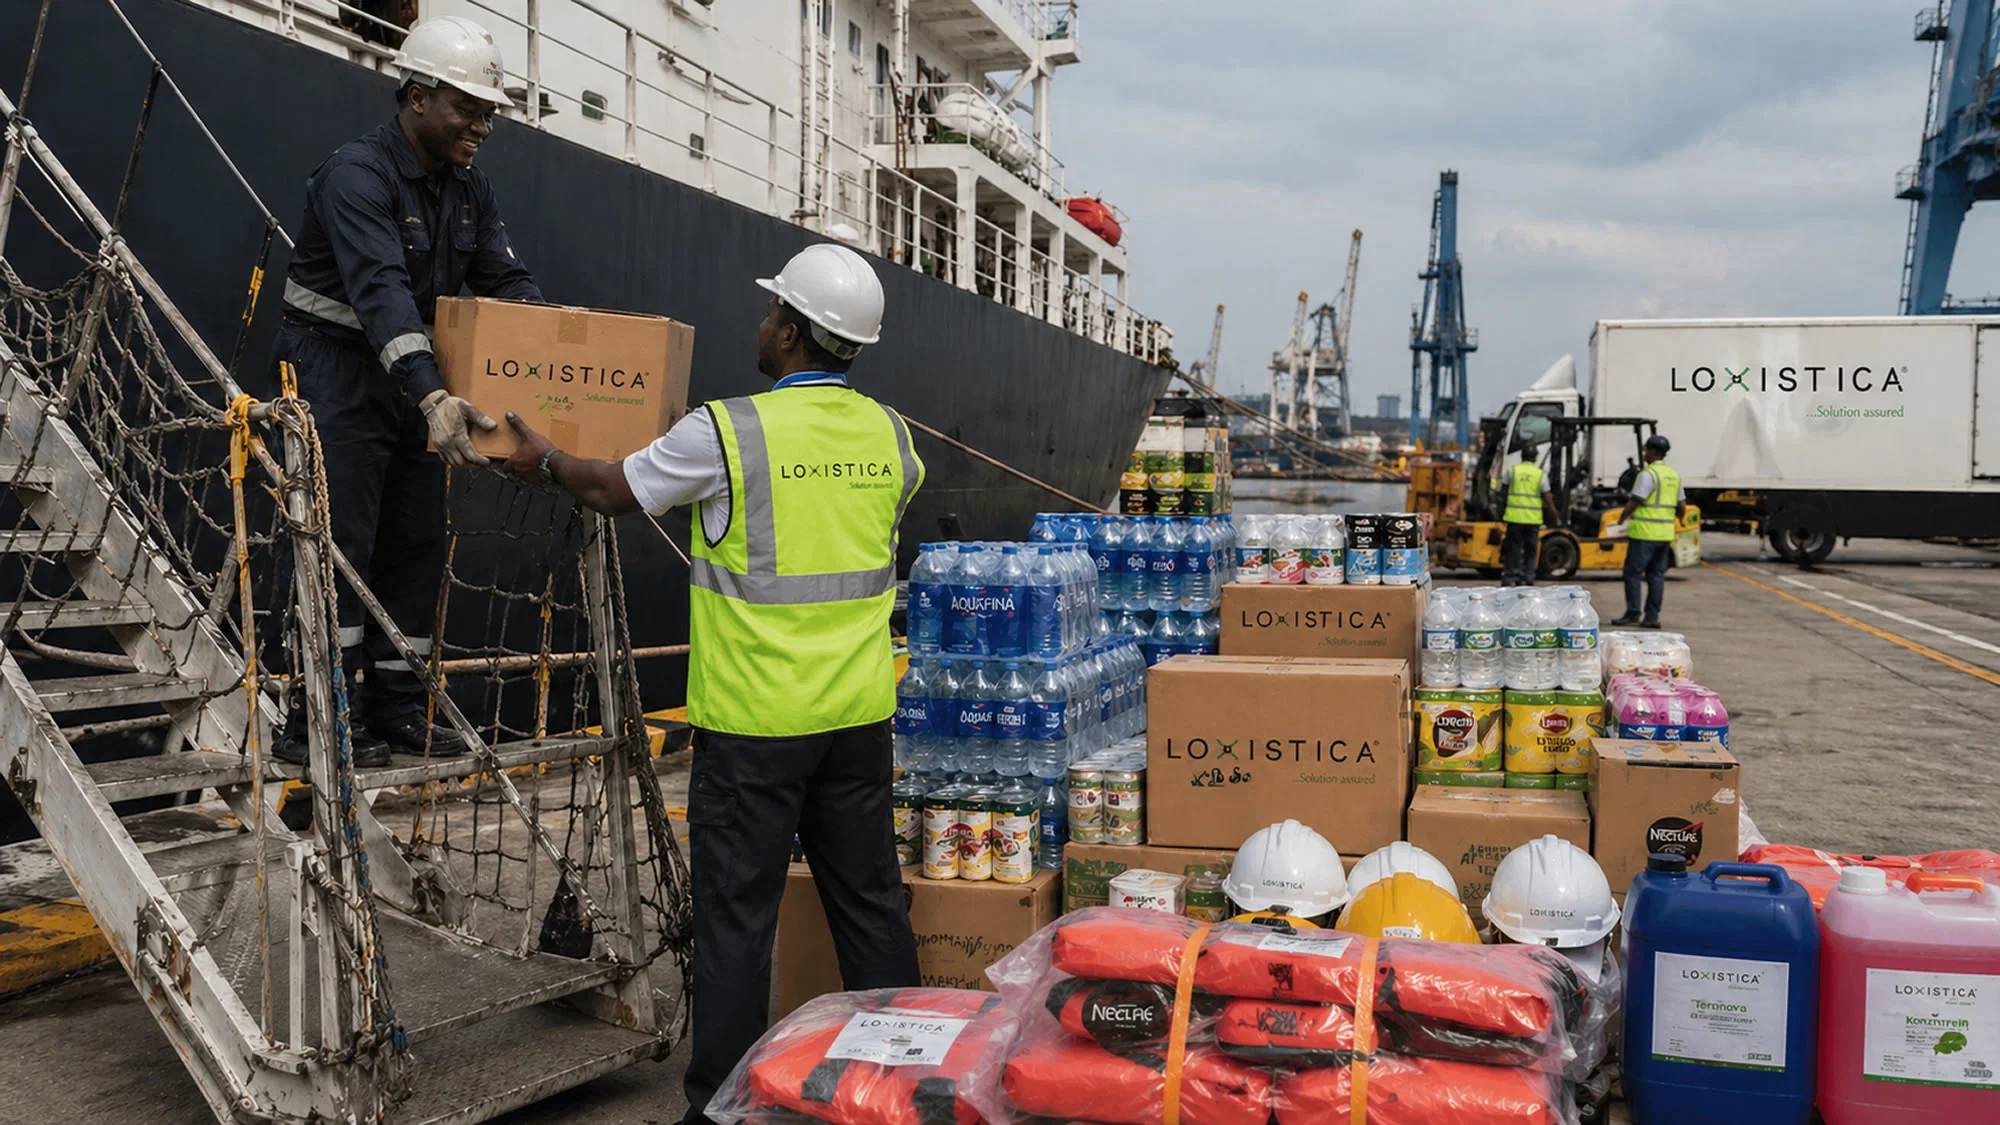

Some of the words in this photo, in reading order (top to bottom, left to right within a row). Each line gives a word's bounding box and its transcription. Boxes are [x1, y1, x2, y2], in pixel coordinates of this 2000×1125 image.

[1863, 406, 1904, 418] assured
[951, 595, 1016, 612] AQUAFINA
[1340, 774, 1376, 785] assured
